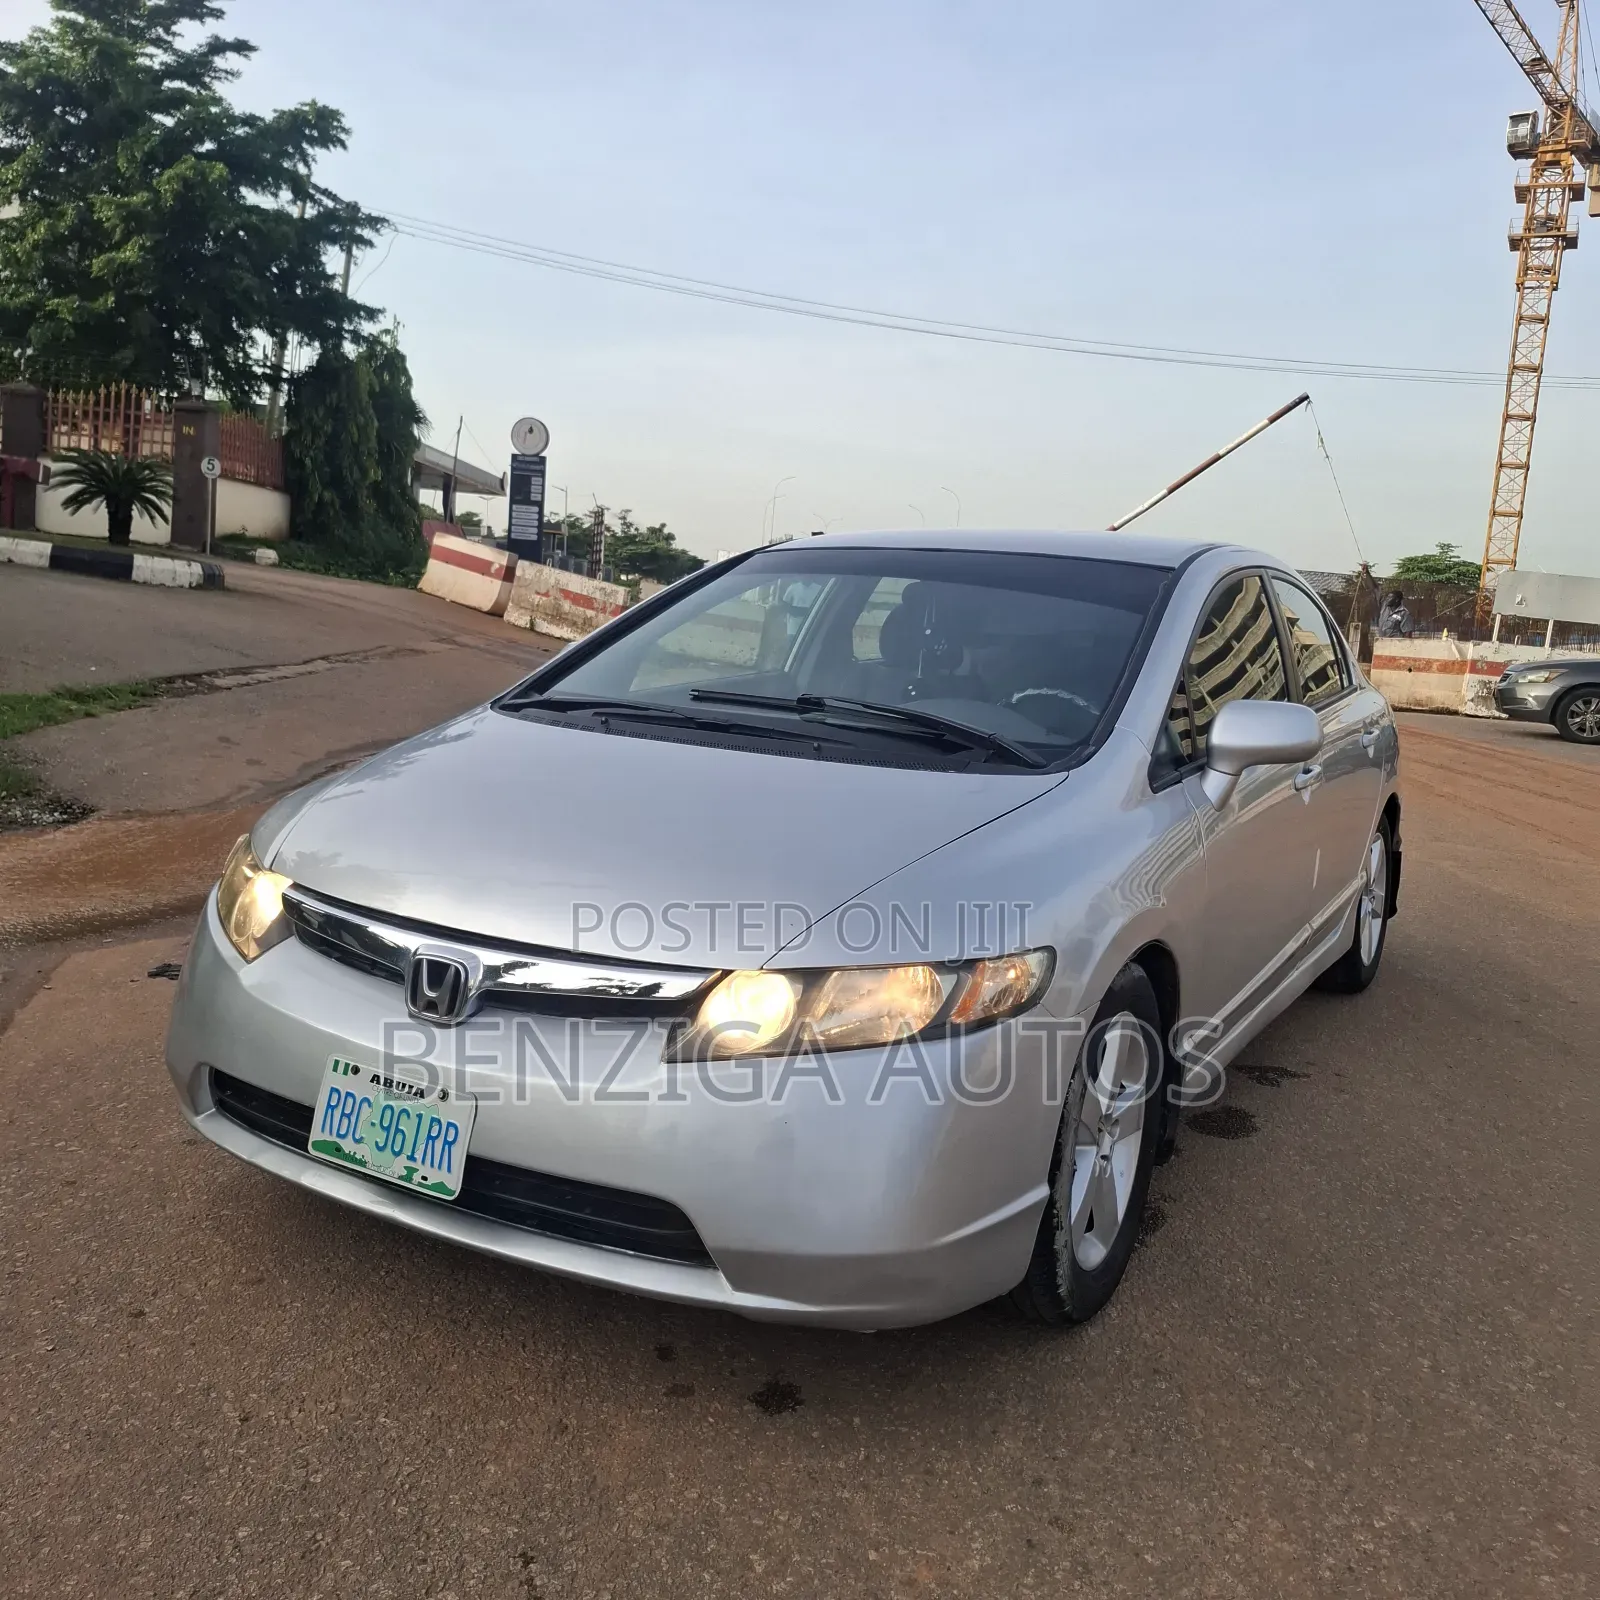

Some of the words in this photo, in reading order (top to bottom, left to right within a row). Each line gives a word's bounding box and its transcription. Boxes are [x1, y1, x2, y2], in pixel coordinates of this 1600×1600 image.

[206, 458, 216, 472] 5
[369, 1073, 425, 1099] ABUJA
[320, 1086, 460, 1174] RBC-961RR
